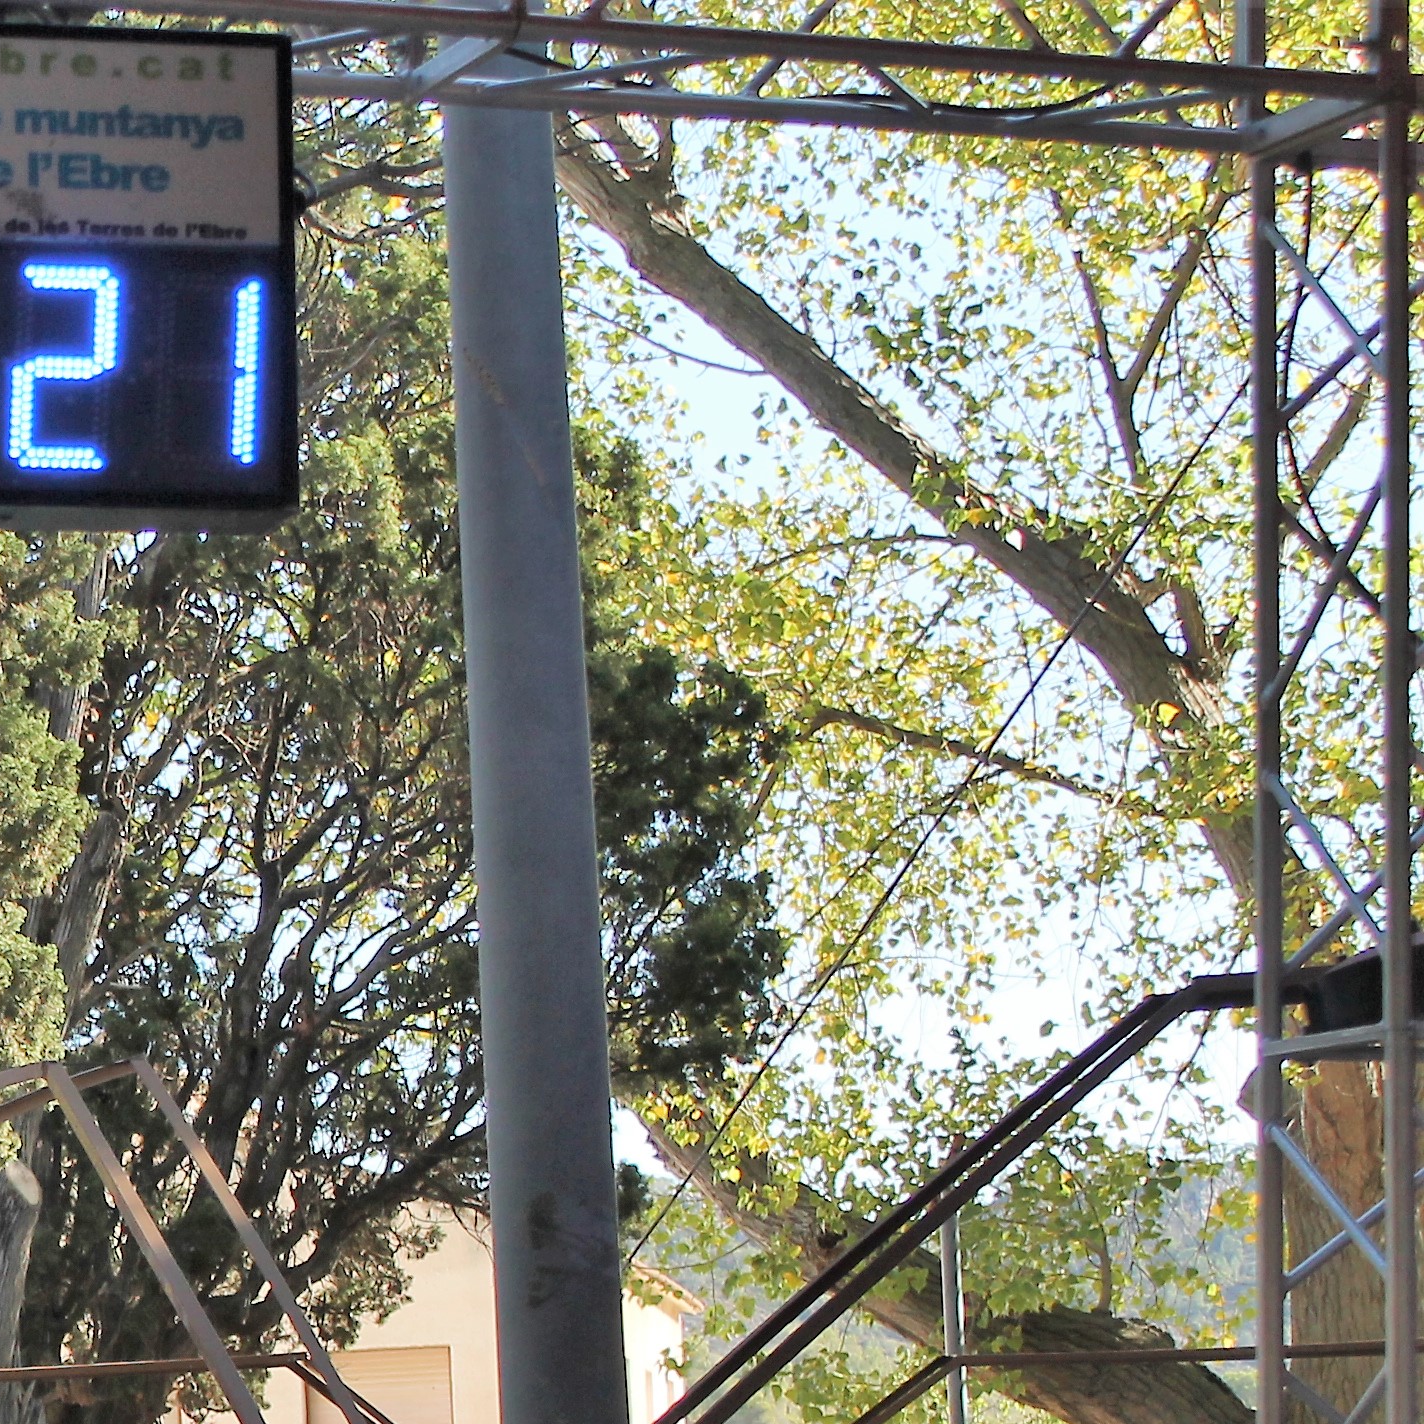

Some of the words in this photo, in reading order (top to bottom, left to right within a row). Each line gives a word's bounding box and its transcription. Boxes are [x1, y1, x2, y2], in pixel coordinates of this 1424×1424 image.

[14, 104, 245, 150] muntanya
[28, 151, 171, 193] l'Ebre
[4, 217, 31, 233] de
[38, 217, 69, 236] les
[77, 218, 146, 237] Terres
[153, 220, 179, 239] de
[6, 264, 262, 470] 21
